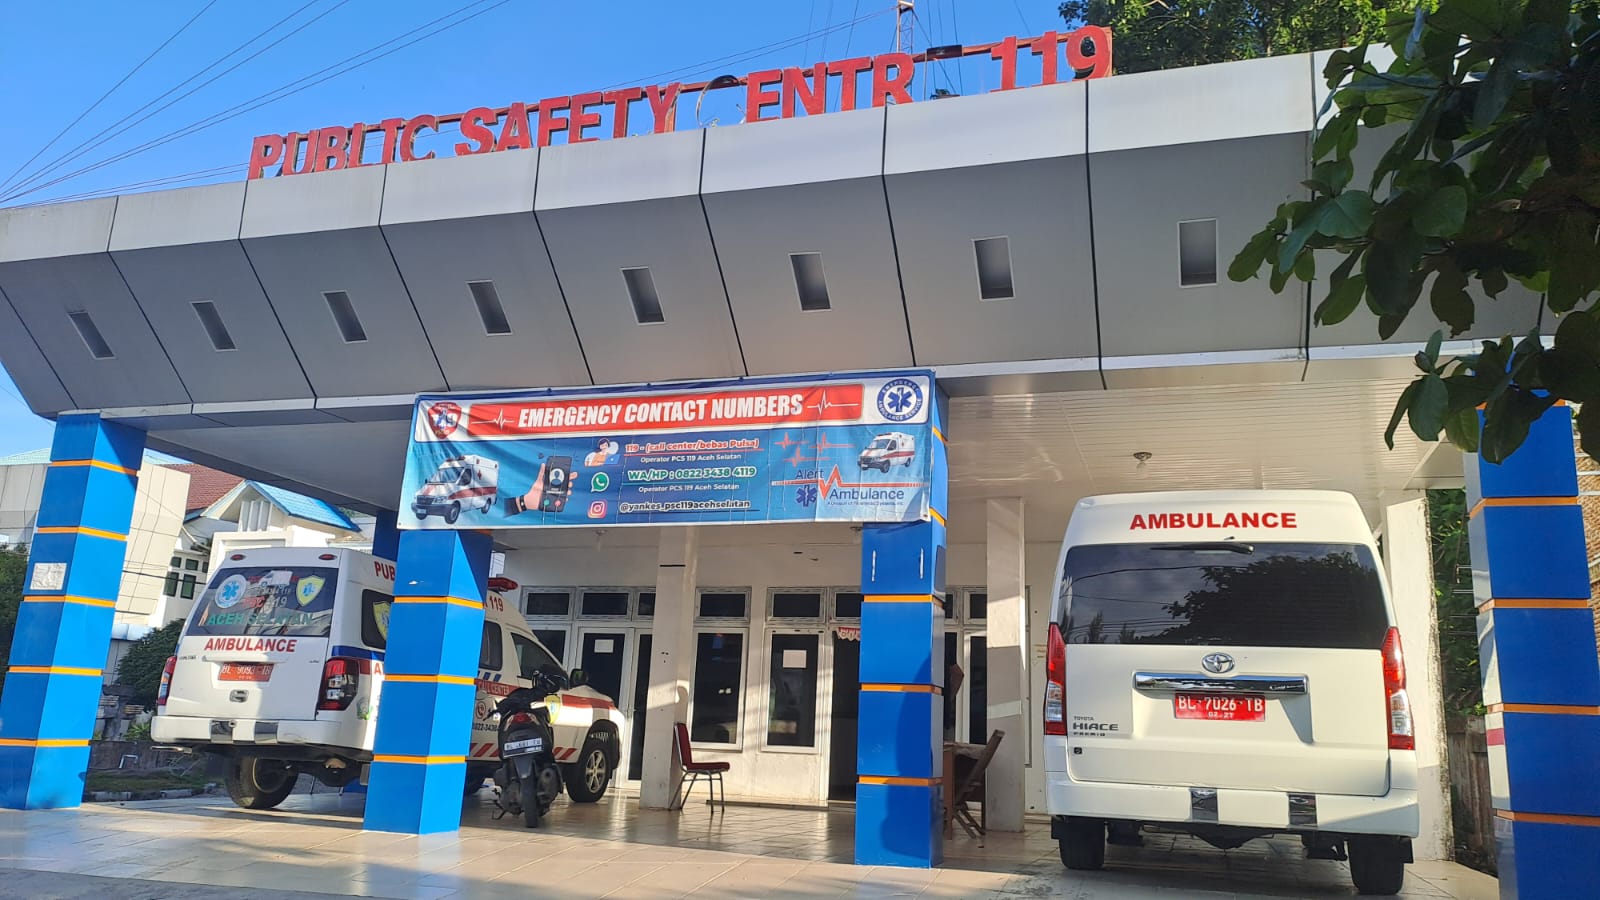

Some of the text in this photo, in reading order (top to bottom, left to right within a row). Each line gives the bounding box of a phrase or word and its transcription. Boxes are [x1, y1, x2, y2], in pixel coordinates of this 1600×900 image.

[247, 115, 438, 180] PUBLIC
[455, 82, 680, 156] SAFETY
[990, 25, 1112, 92] 119
[518, 394, 803, 428] EMERGENCY CONTACT NUMBERS
[625, 444, 639, 453] 119
[640, 456, 670, 464] Operator
[628, 469, 668, 481] WA/HP
[676, 469, 701, 480] 0822
[703, 467, 731, 479] 3438
[732, 466, 757, 478] 4119
[796, 469, 824, 479] Alert
[829, 488, 905, 500] Ambulance
[1129, 512, 1297, 530] AMBULANCE
[489, 595, 504, 612] 119
[206, 613, 243, 625] ACEH
[204, 638, 297, 652] AMBULANCE
[1178, 695, 1264, 712] BL 7026 TB
[1073, 722, 1119, 731] HIACE
